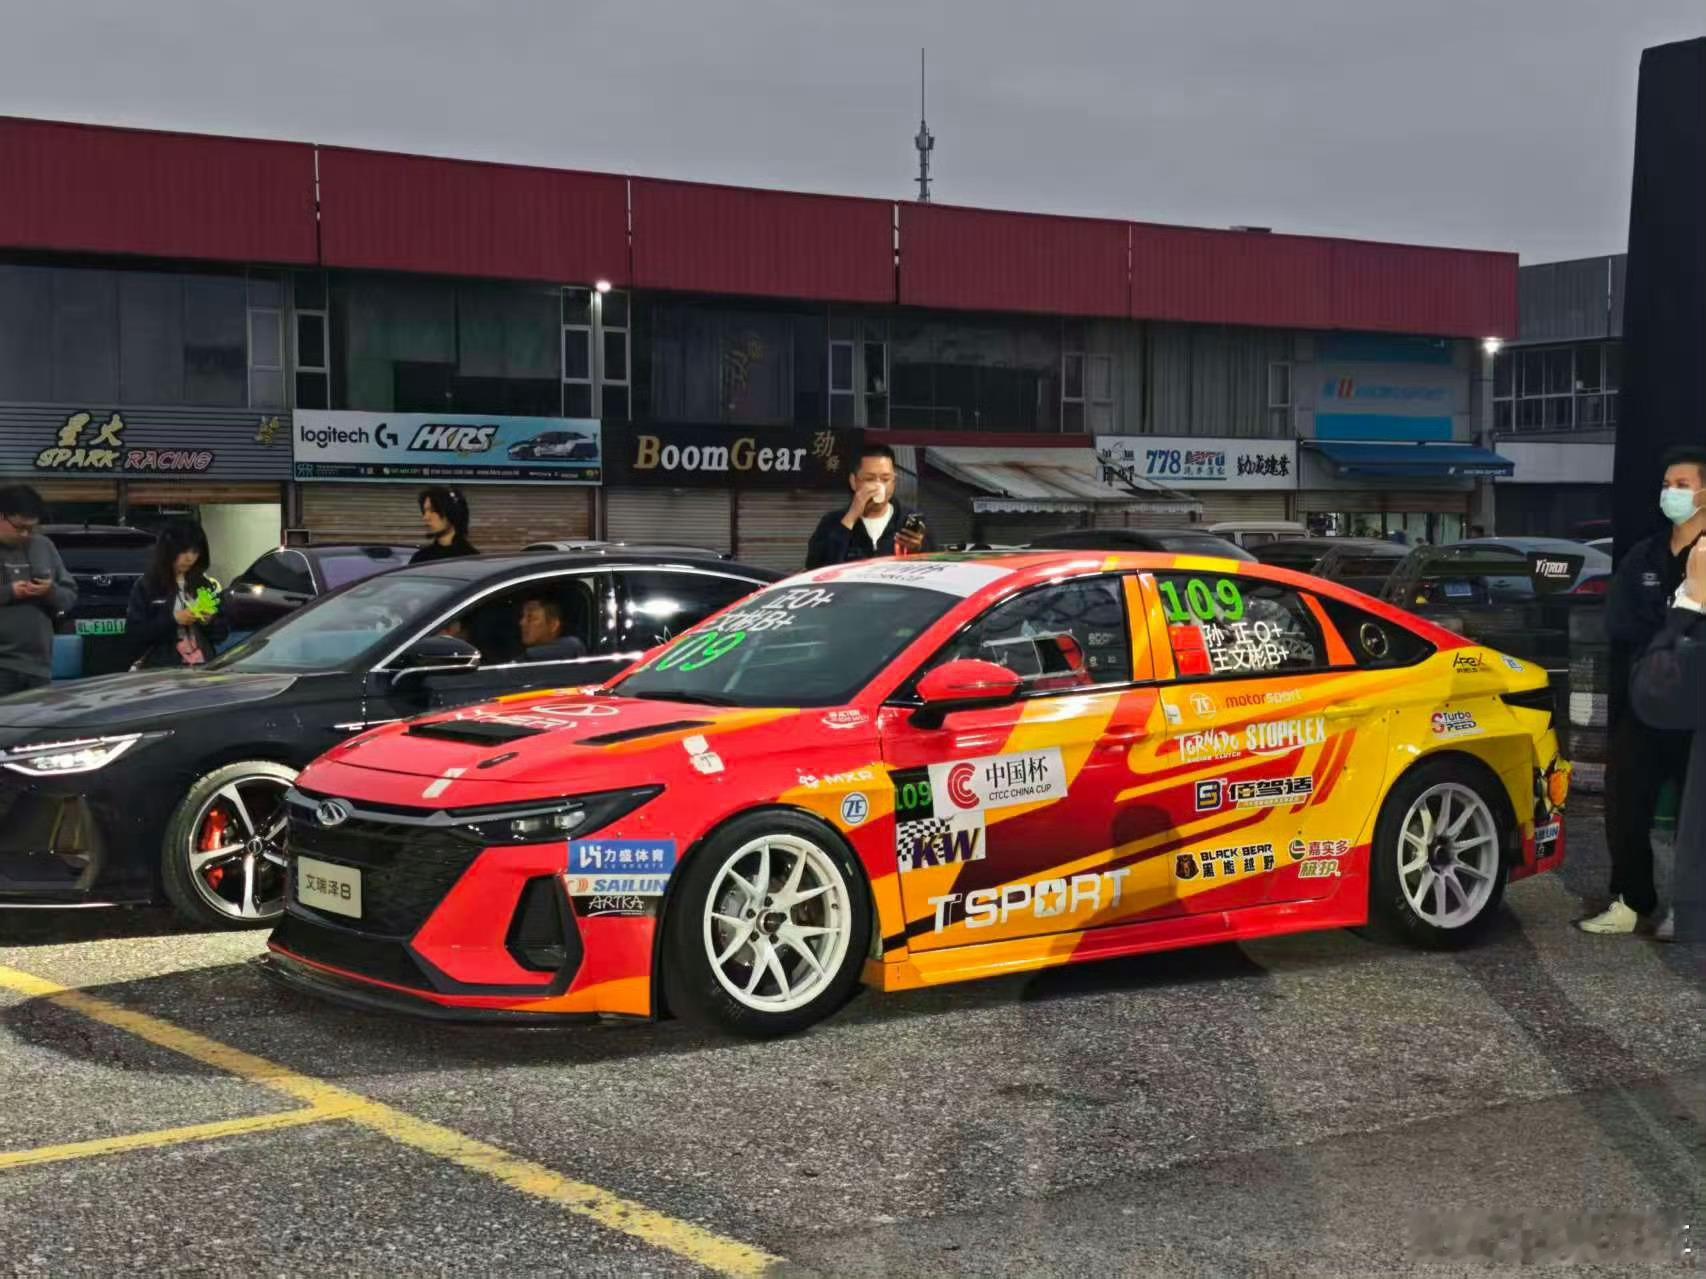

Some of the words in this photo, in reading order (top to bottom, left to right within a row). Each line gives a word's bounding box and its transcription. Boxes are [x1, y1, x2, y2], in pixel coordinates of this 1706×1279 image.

[300, 426, 369, 449] logitech
[409, 425, 497, 451] HKRS
[124, 450, 213, 470] RACING
[633, 435, 807, 471] BoomGear
[1146, 449, 1182, 474] 778
[1160, 578, 1246, 622] 109
[1443, 711, 1472, 721] Turbo
[1245, 717, 1326, 751] STOPFLEX
[986, 756, 1048, 789] 中国杯
[988, 790, 1010, 801] CTCC
[1010, 786, 1035, 799] CHINA
[1035, 783, 1052, 794] CUP
[912, 826, 980, 870] KW
[1200, 848, 1238, 861] BLACK
[1242, 844, 1272, 856] BEAR
[593, 879, 666, 893] SAILUN
[588, 896, 644, 909] ARTKA
